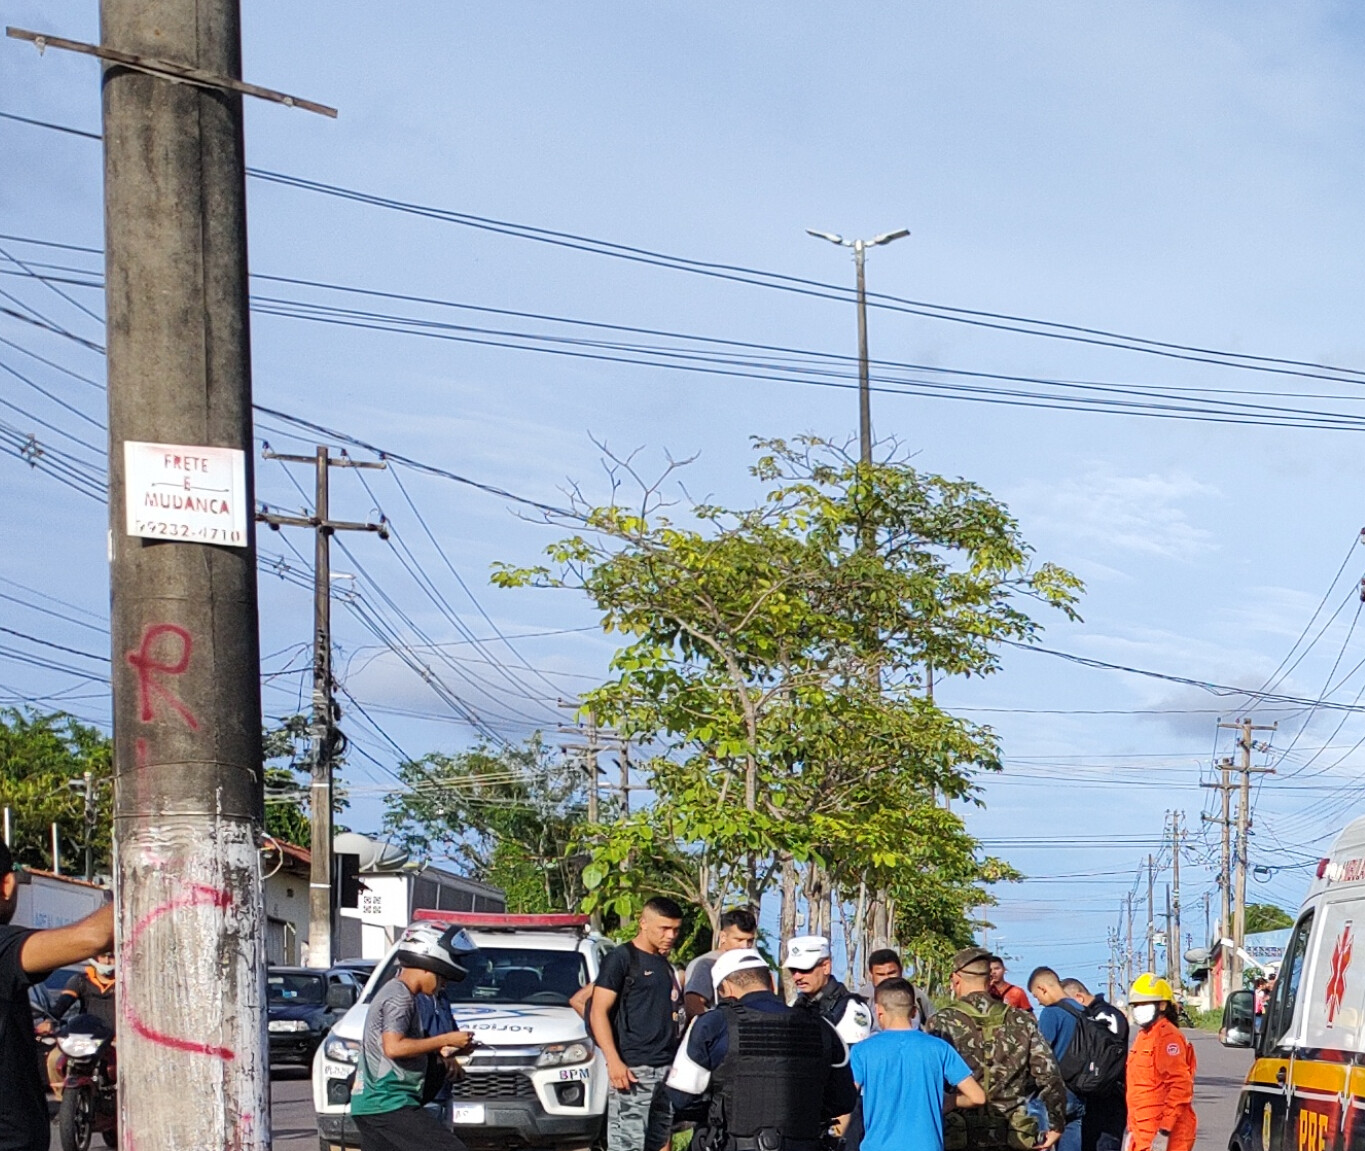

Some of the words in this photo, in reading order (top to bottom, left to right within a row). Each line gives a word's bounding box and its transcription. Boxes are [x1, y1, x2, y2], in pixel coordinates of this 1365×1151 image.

[164, 454, 208, 473] FRETE
[183, 476, 191, 491] E
[559, 1068, 590, 1081] BPM
